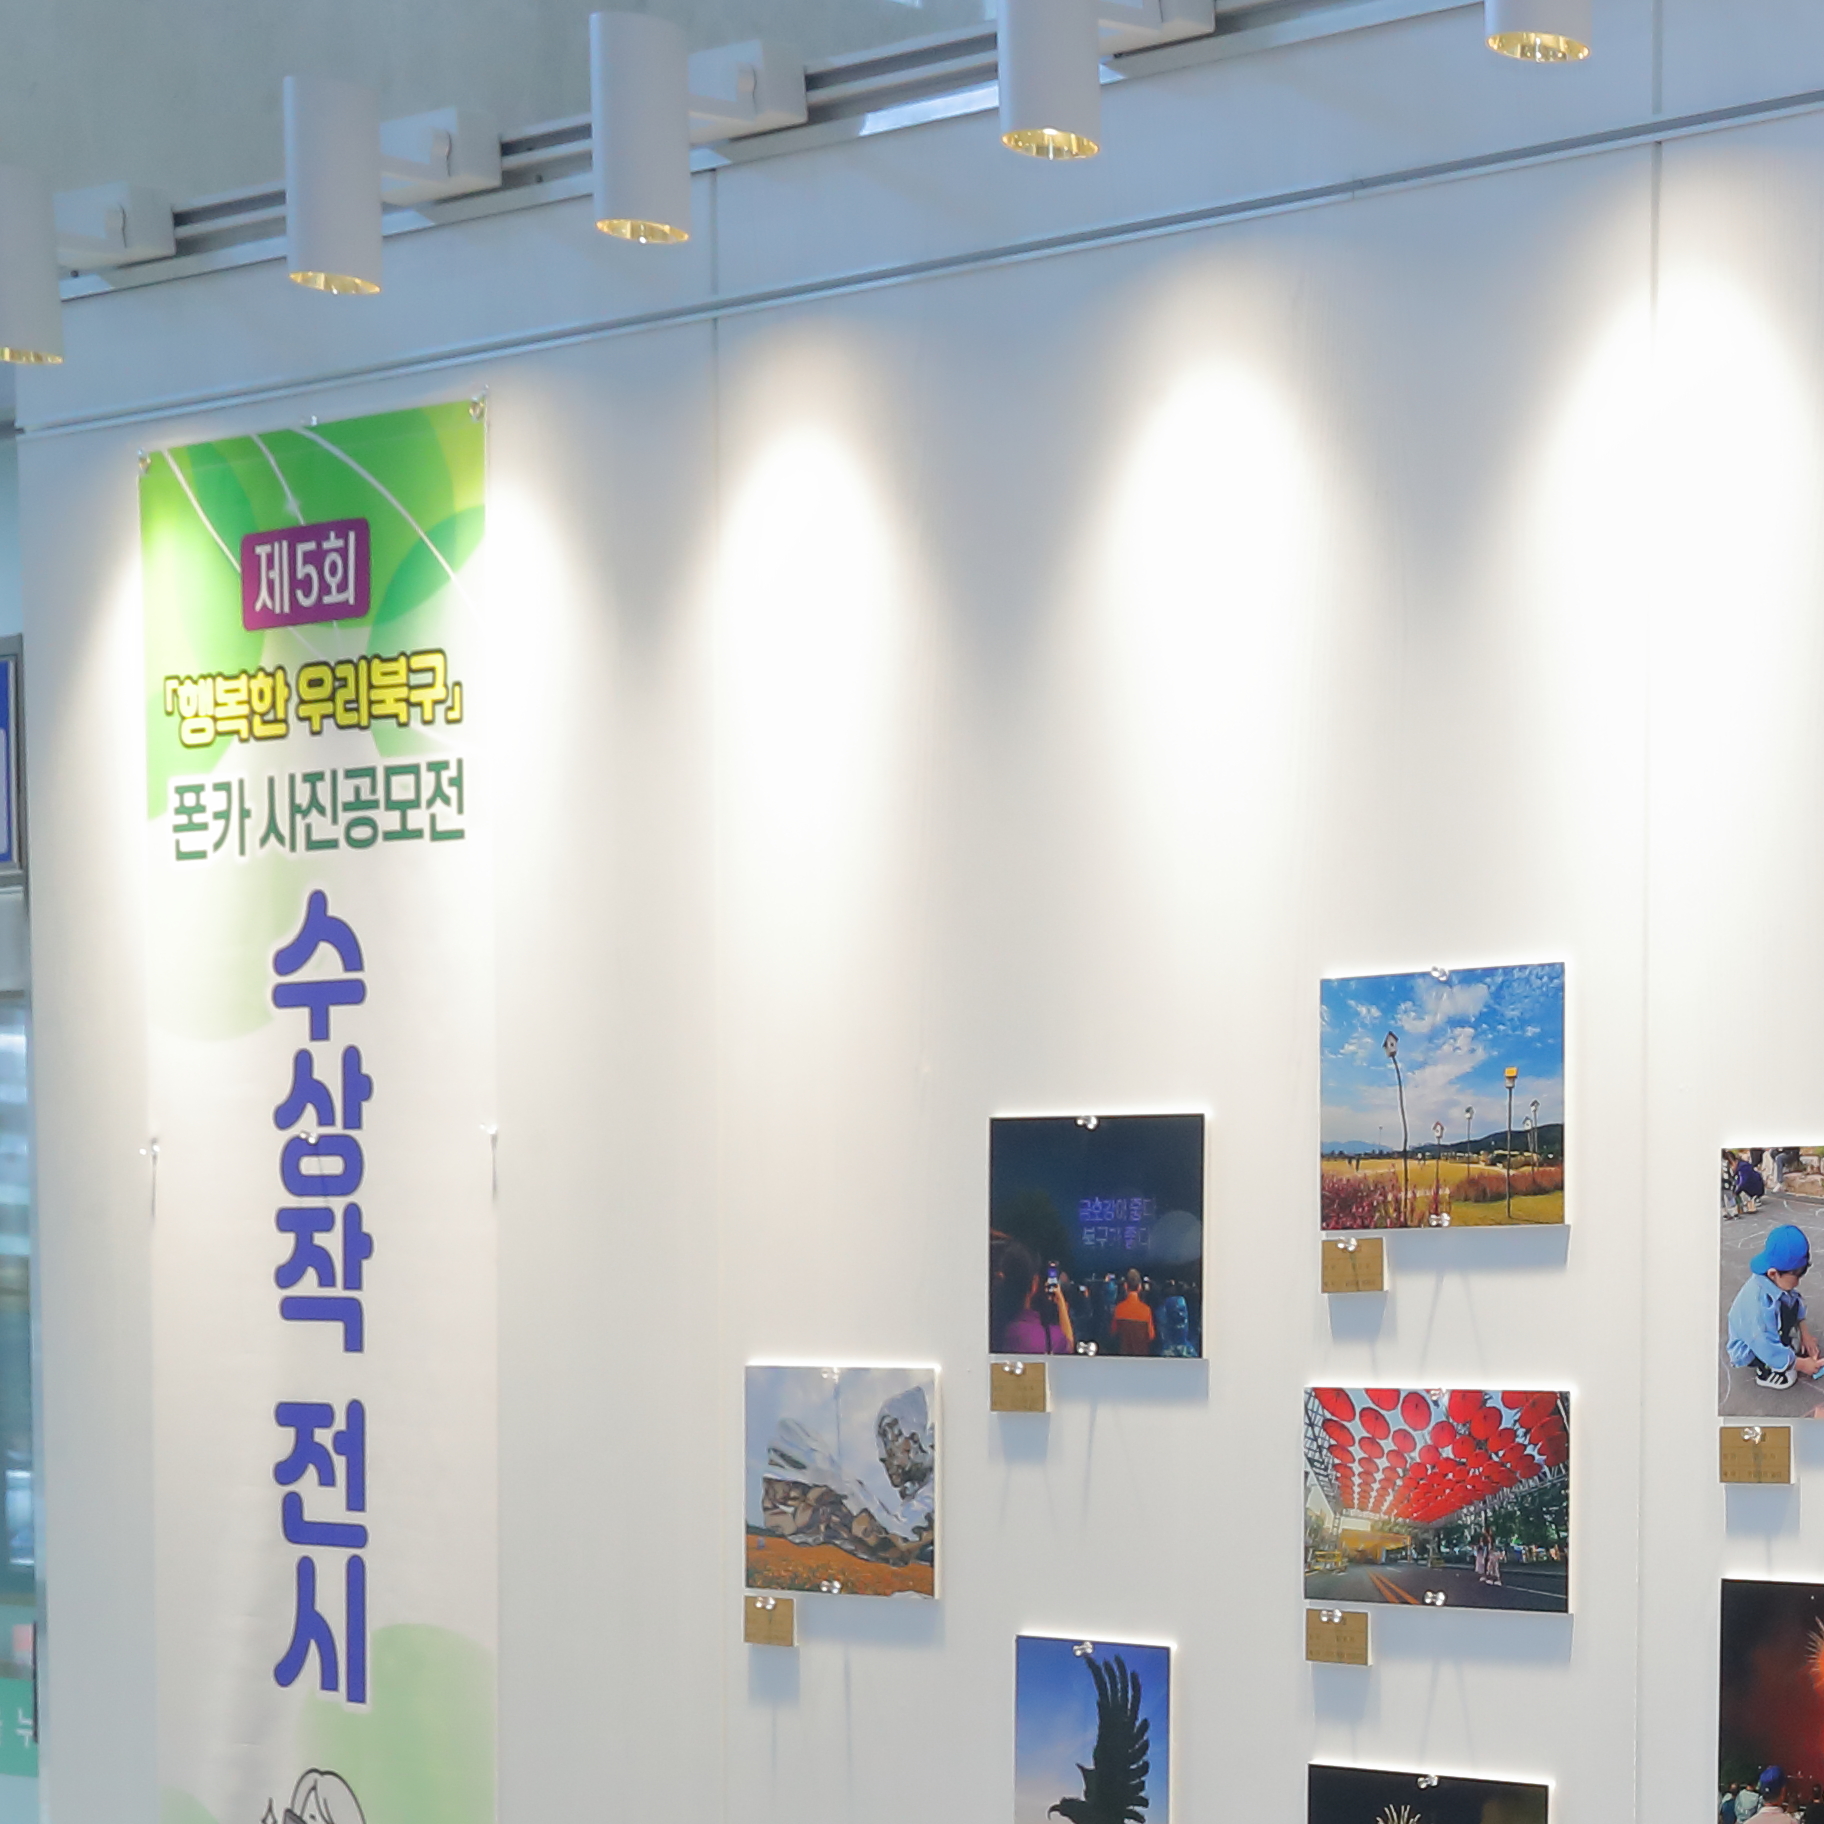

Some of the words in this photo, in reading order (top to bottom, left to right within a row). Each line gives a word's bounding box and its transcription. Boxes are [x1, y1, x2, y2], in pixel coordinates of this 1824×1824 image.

[254, 530, 356, 614] 제5회
[172, 778, 251, 861] 폰카
[259, 757, 466, 853] 사진공모전
[271, 889, 374, 1354] 수상작
[272, 1398, 370, 1704] 전시
